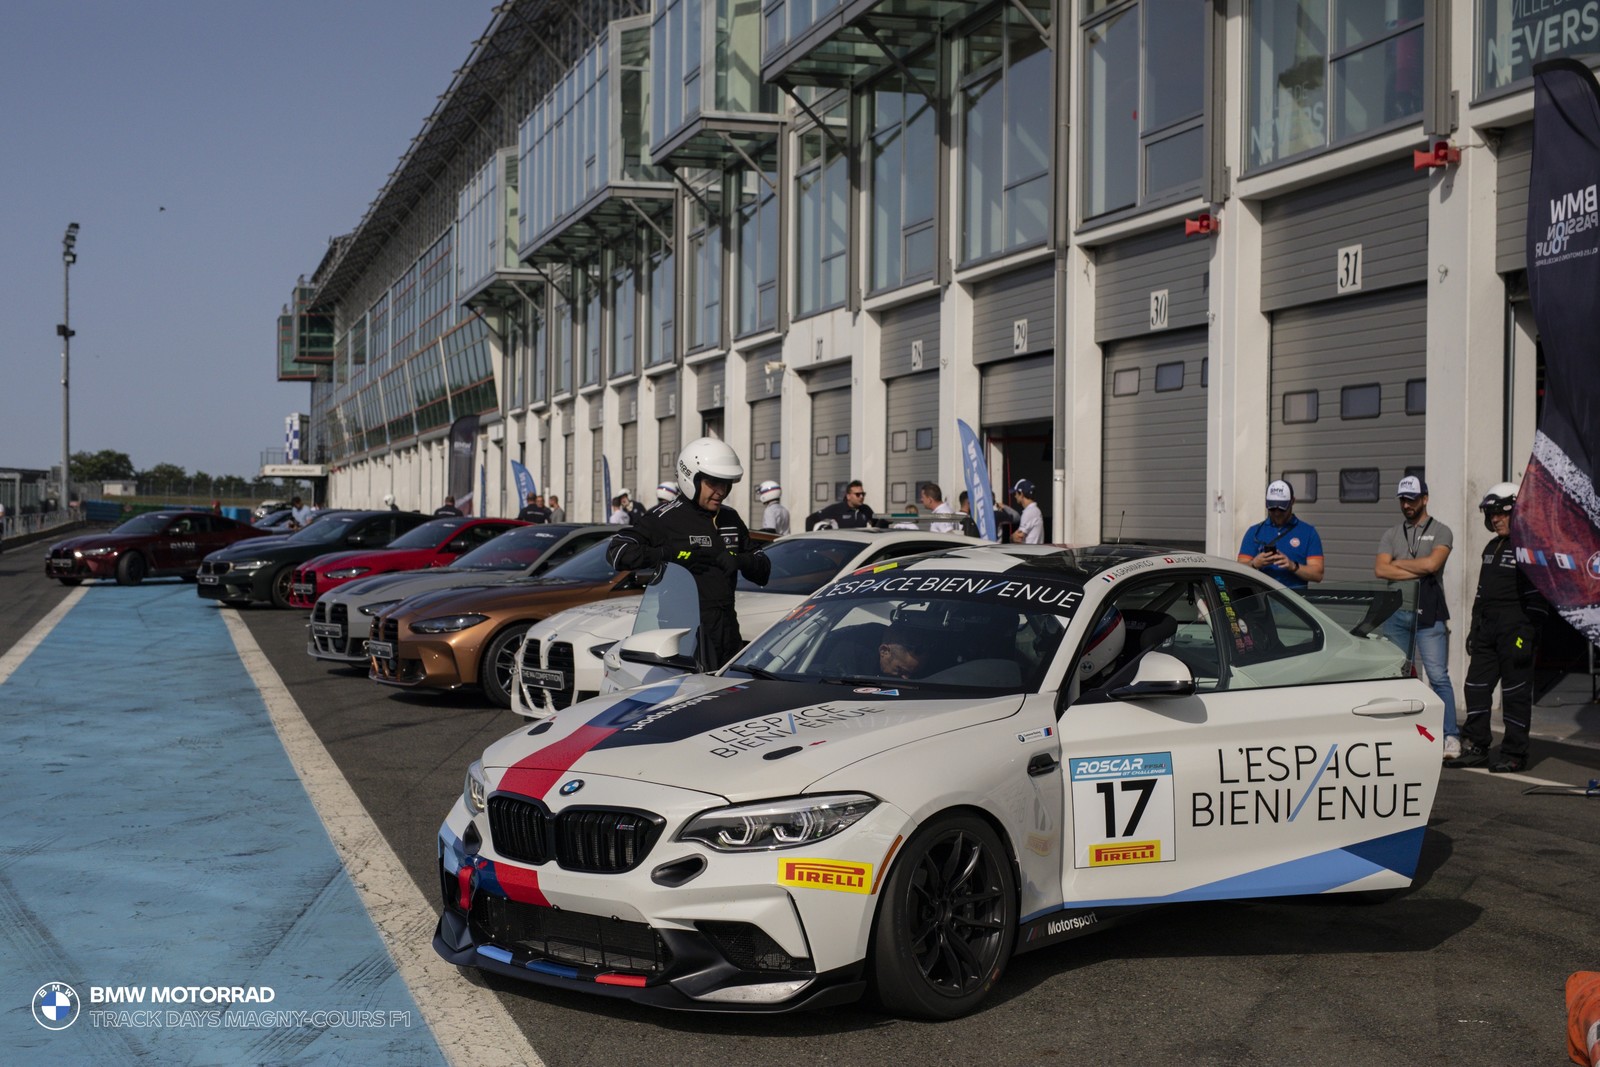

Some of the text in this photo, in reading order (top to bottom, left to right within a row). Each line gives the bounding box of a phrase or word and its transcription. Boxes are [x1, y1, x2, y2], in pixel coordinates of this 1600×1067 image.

[1487, 1, 1599, 74] NEVERS
[1340, 250, 1359, 289] 31
[1151, 294, 1167, 326] 30
[1015, 324, 1026, 350] 29
[812, 577, 1083, 608] L'ESPACE BIENVENUE
[709, 705, 844, 744] L'ESPACE
[1076, 758, 1143, 774] ROSCAR
[1131, 769, 1167, 777] CHALLENGE
[1218, 742, 1395, 785] L'ESPACE
[1096, 779, 1158, 838] 17
[1192, 783, 1422, 827] BIENVENUE
[1095, 844, 1155, 862] PIRELLI
[786, 862, 865, 887] PIRELLI
[1047, 911, 1098, 936] Motorsport
